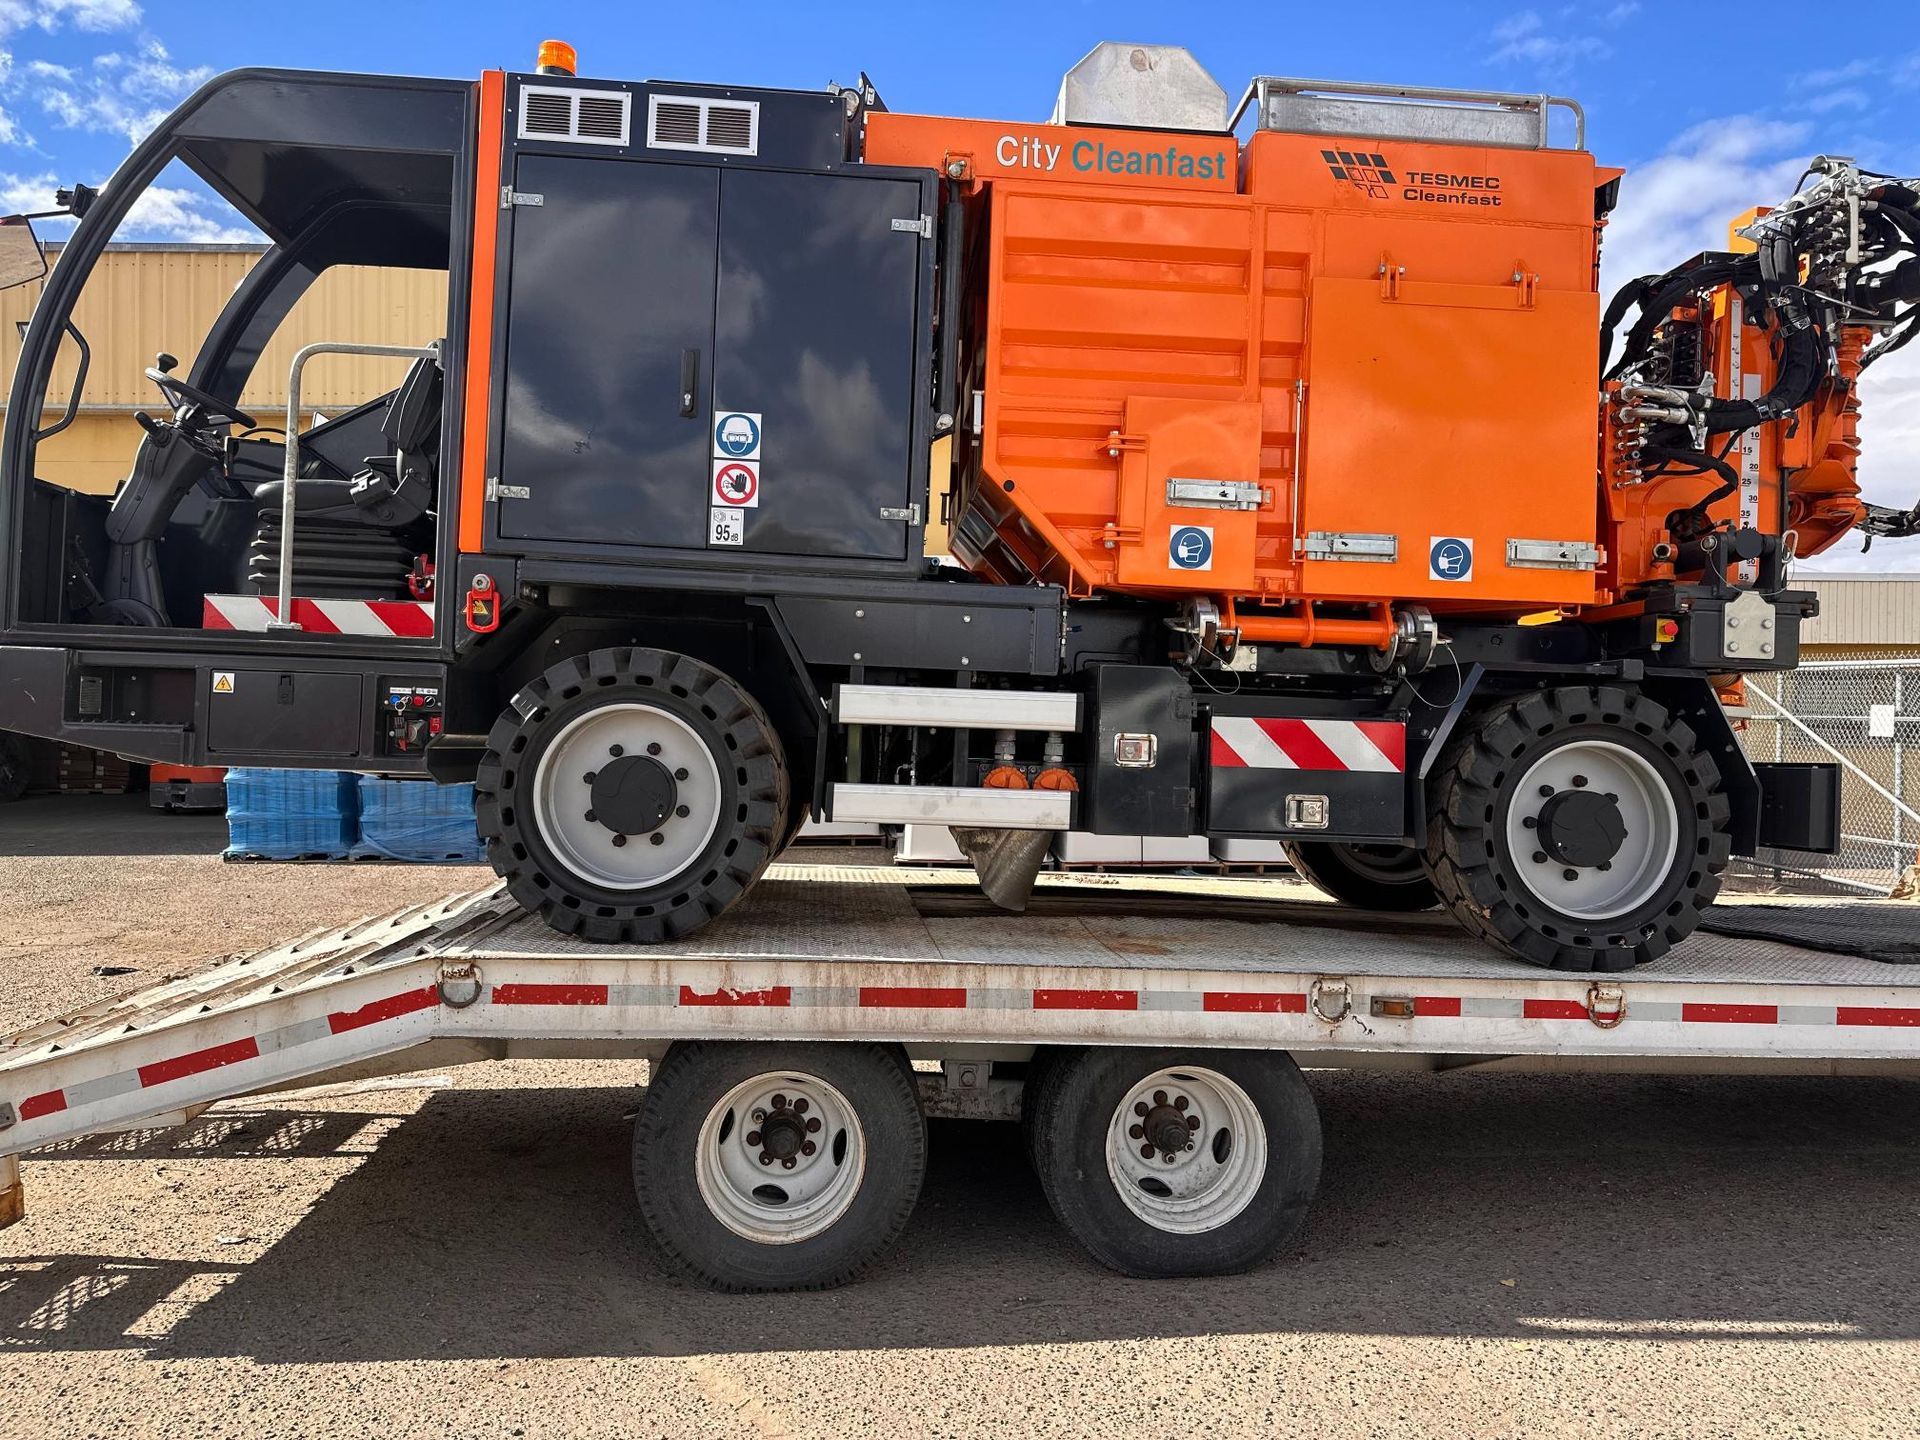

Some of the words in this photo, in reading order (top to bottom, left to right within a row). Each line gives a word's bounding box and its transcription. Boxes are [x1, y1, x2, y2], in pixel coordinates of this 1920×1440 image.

[996, 135, 1062, 172] City
[1072, 140, 1226, 180] Cleanfast
[1406, 172, 1500, 189] TESMEC
[1403, 189, 1502, 206] Cleanfast
[716, 524, 730, 541] 95
[731, 533, 739, 541] dB
